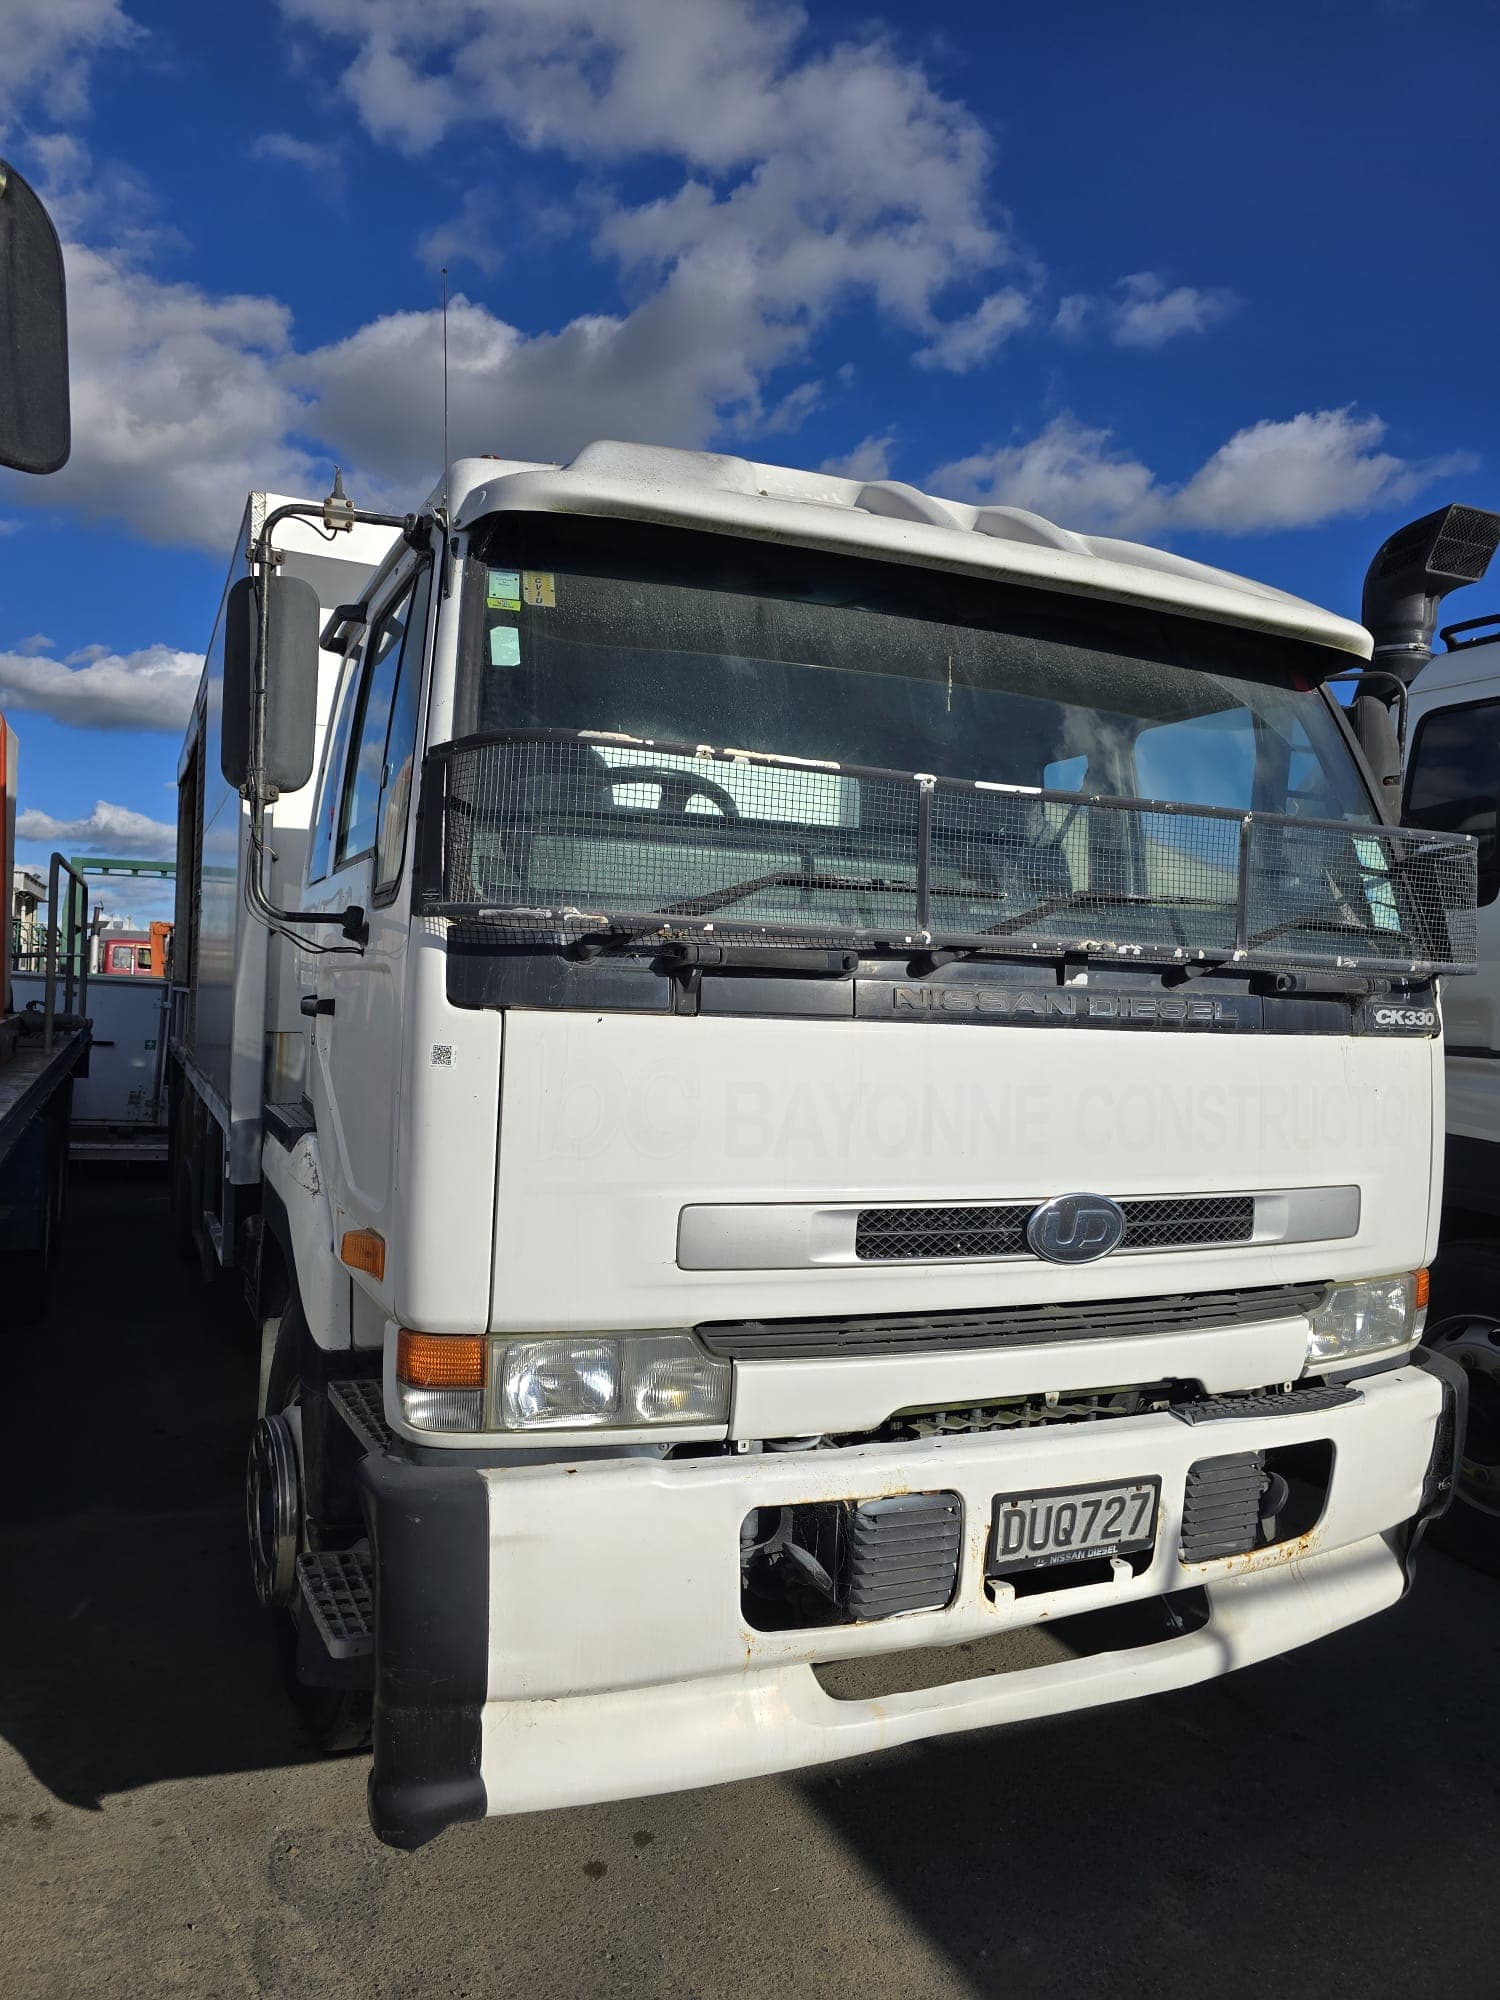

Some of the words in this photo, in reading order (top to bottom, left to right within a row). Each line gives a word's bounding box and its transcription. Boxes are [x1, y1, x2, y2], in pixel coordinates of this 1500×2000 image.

[893, 988, 1078, 1015] NISSAN
[1088, 996, 1239, 1020] DIESEL
[1376, 1009, 1434, 1026] CK330
[724, 1081, 1051, 1159] BAYONNE
[1041, 1208, 1117, 1250] UD
[1001, 1492, 1151, 1556] DUQ727
[1050, 1552, 1086, 1565] NISSAN
[1087, 1545, 1119, 1559] DIESEL
